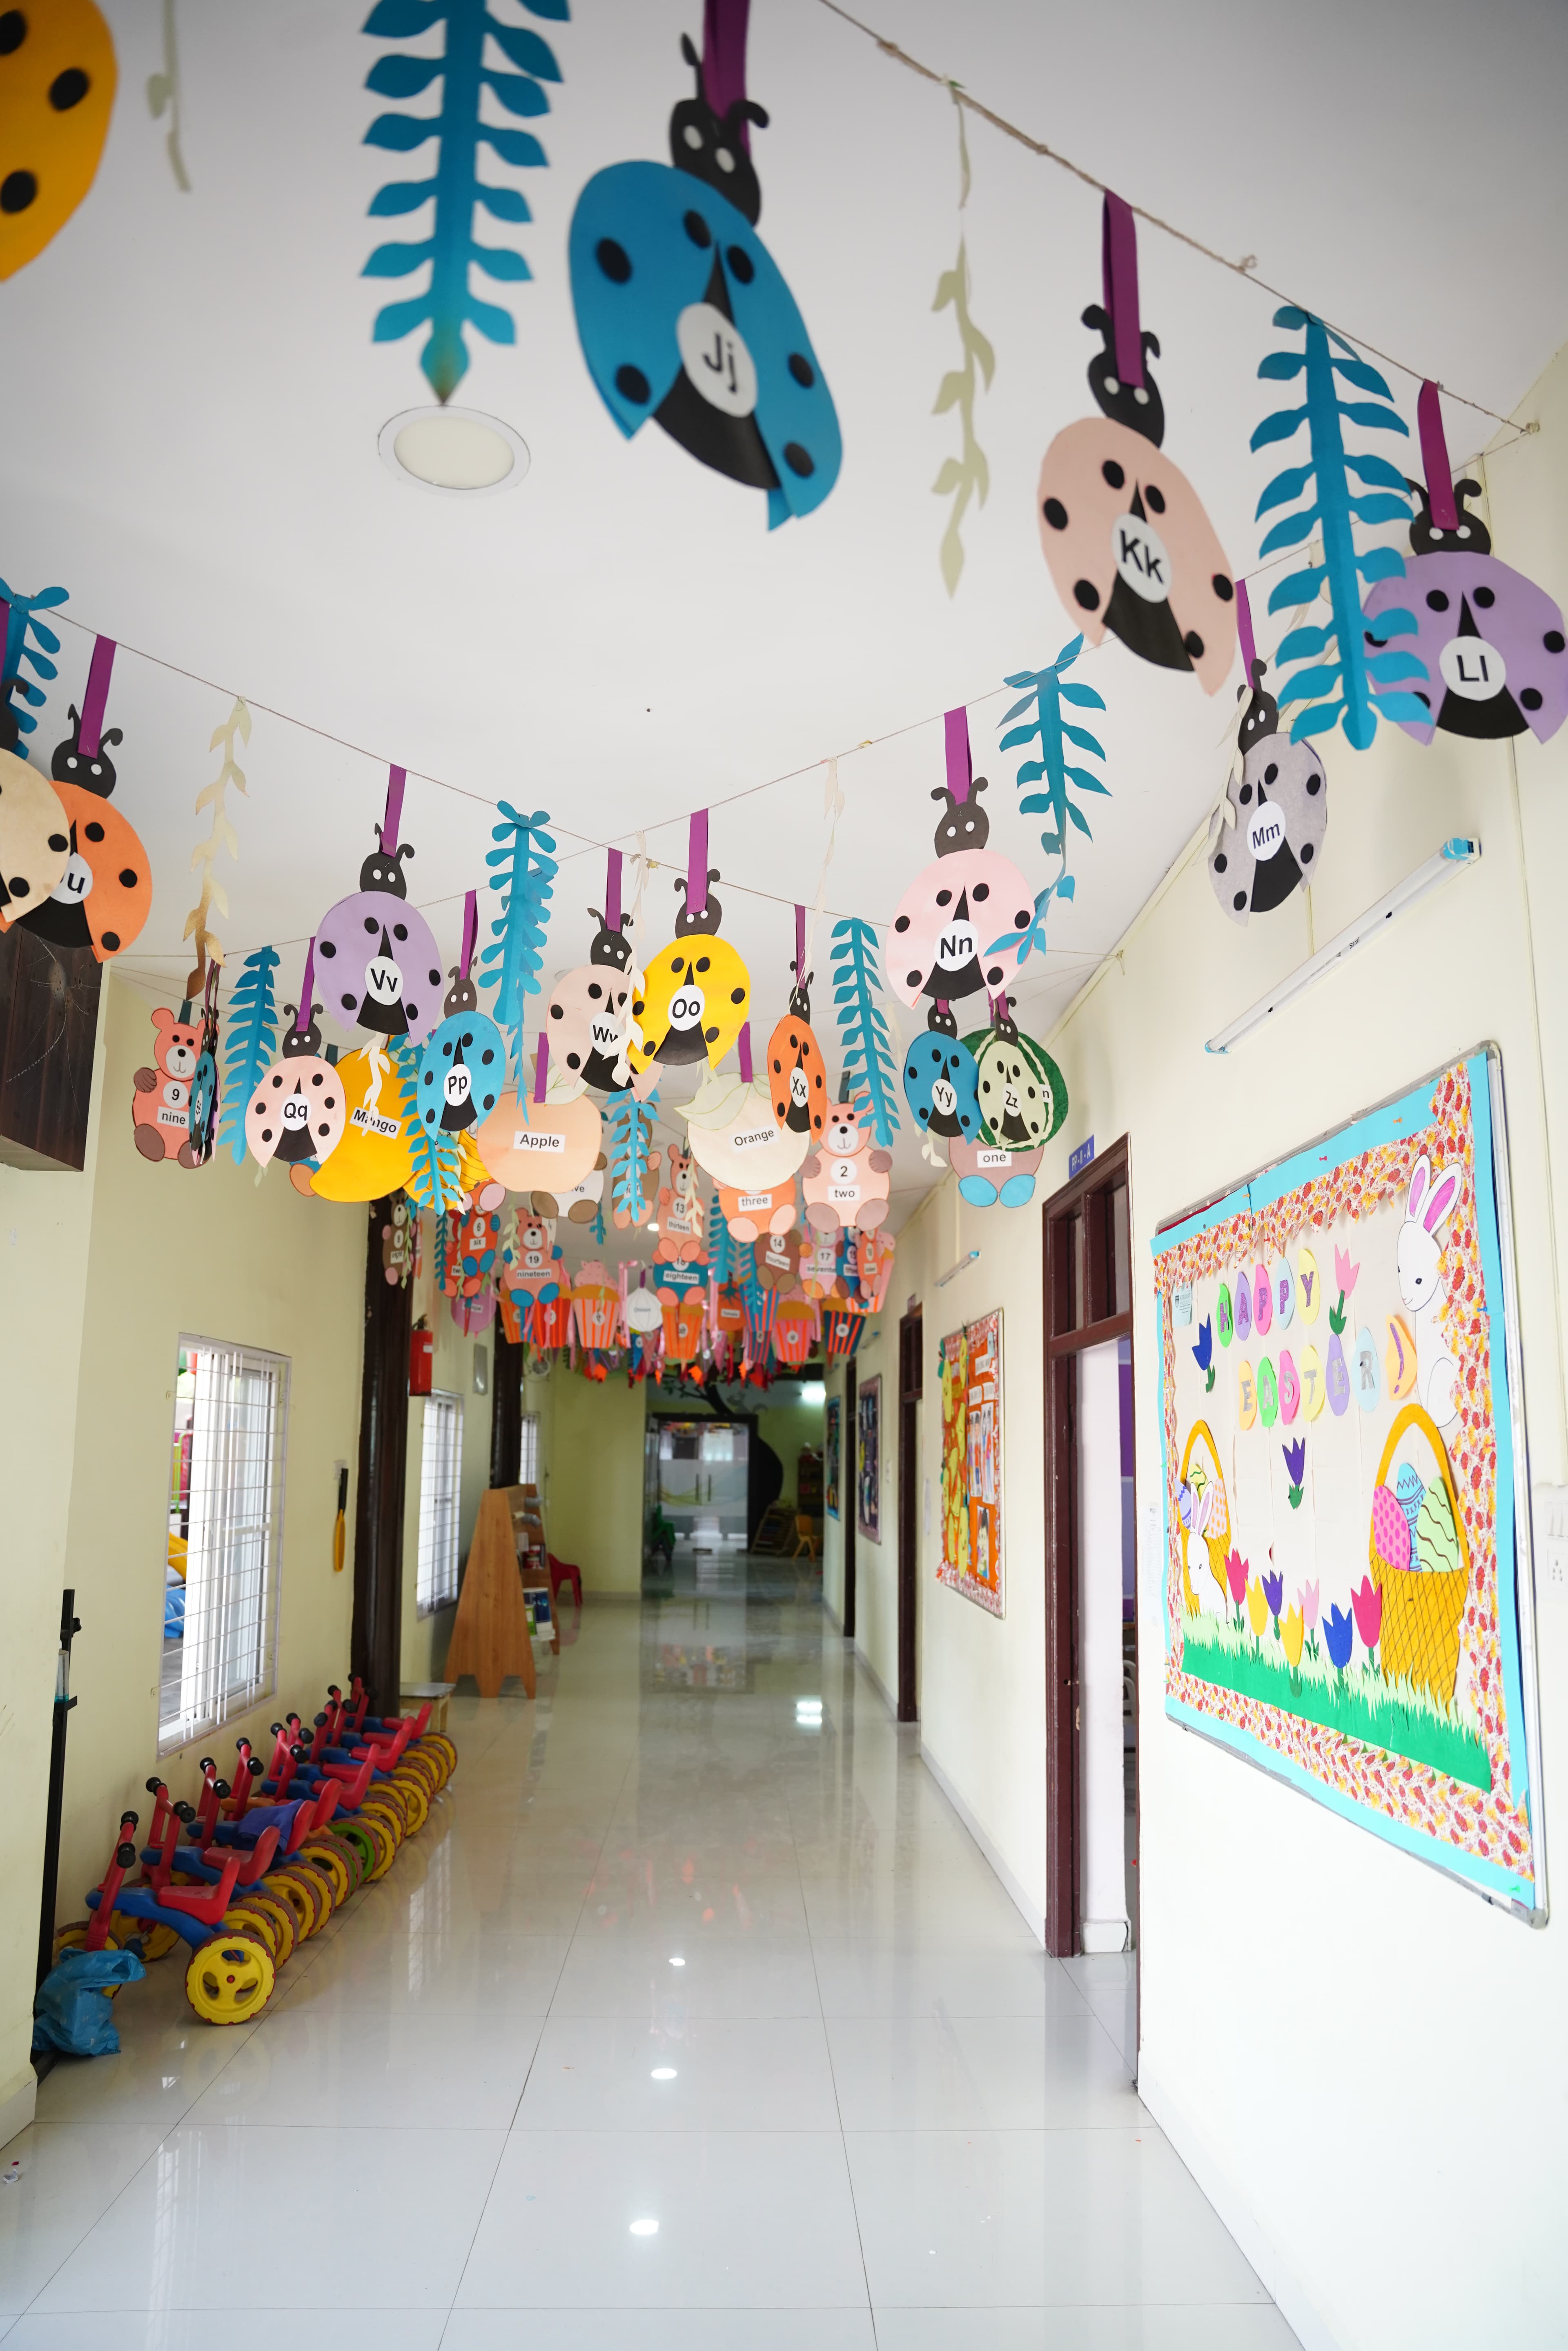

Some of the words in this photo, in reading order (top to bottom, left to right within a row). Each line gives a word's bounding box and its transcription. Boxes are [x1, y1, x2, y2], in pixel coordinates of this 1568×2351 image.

[702, 333, 737, 393] Jj
[1119, 529, 1164, 584] Kk
[1252, 821, 1281, 849] Mm
[60, 872, 86, 894] u
[940, 935, 973, 959] Nn
[1349, 936, 1360, 949] Saral
[370, 968, 398, 992] Vv
[672, 998, 700, 1018] Oo
[448, 1076, 468, 1095] Pp
[792, 1076, 806, 1098] Xx
[172, 1089, 180, 1100] 9
[935, 1086, 953, 1105] Yy
[1006, 1092, 1018, 1109] Zz
[162, 1112, 186, 1124] nine
[284, 1103, 308, 1121] Qq
[519, 1134, 560, 1148] Apple
[734, 1129, 774, 1146] Orange
[983, 1152, 1007, 1163] one
[840, 1166, 848, 1177] 2
[741, 1196, 768, 1206] three
[834, 1190, 855, 1198] two
[675, 1203, 684, 1214] 13
[477, 1223, 481, 1231] 6
[668, 1221, 689, 1232] thirteen
[774, 1239, 782, 1248] 14
[528, 1255, 539, 1264] 19
[1219, 1270, 1314, 1333] HAPPY
[1241, 1323, 1405, 1412] EASTER!
